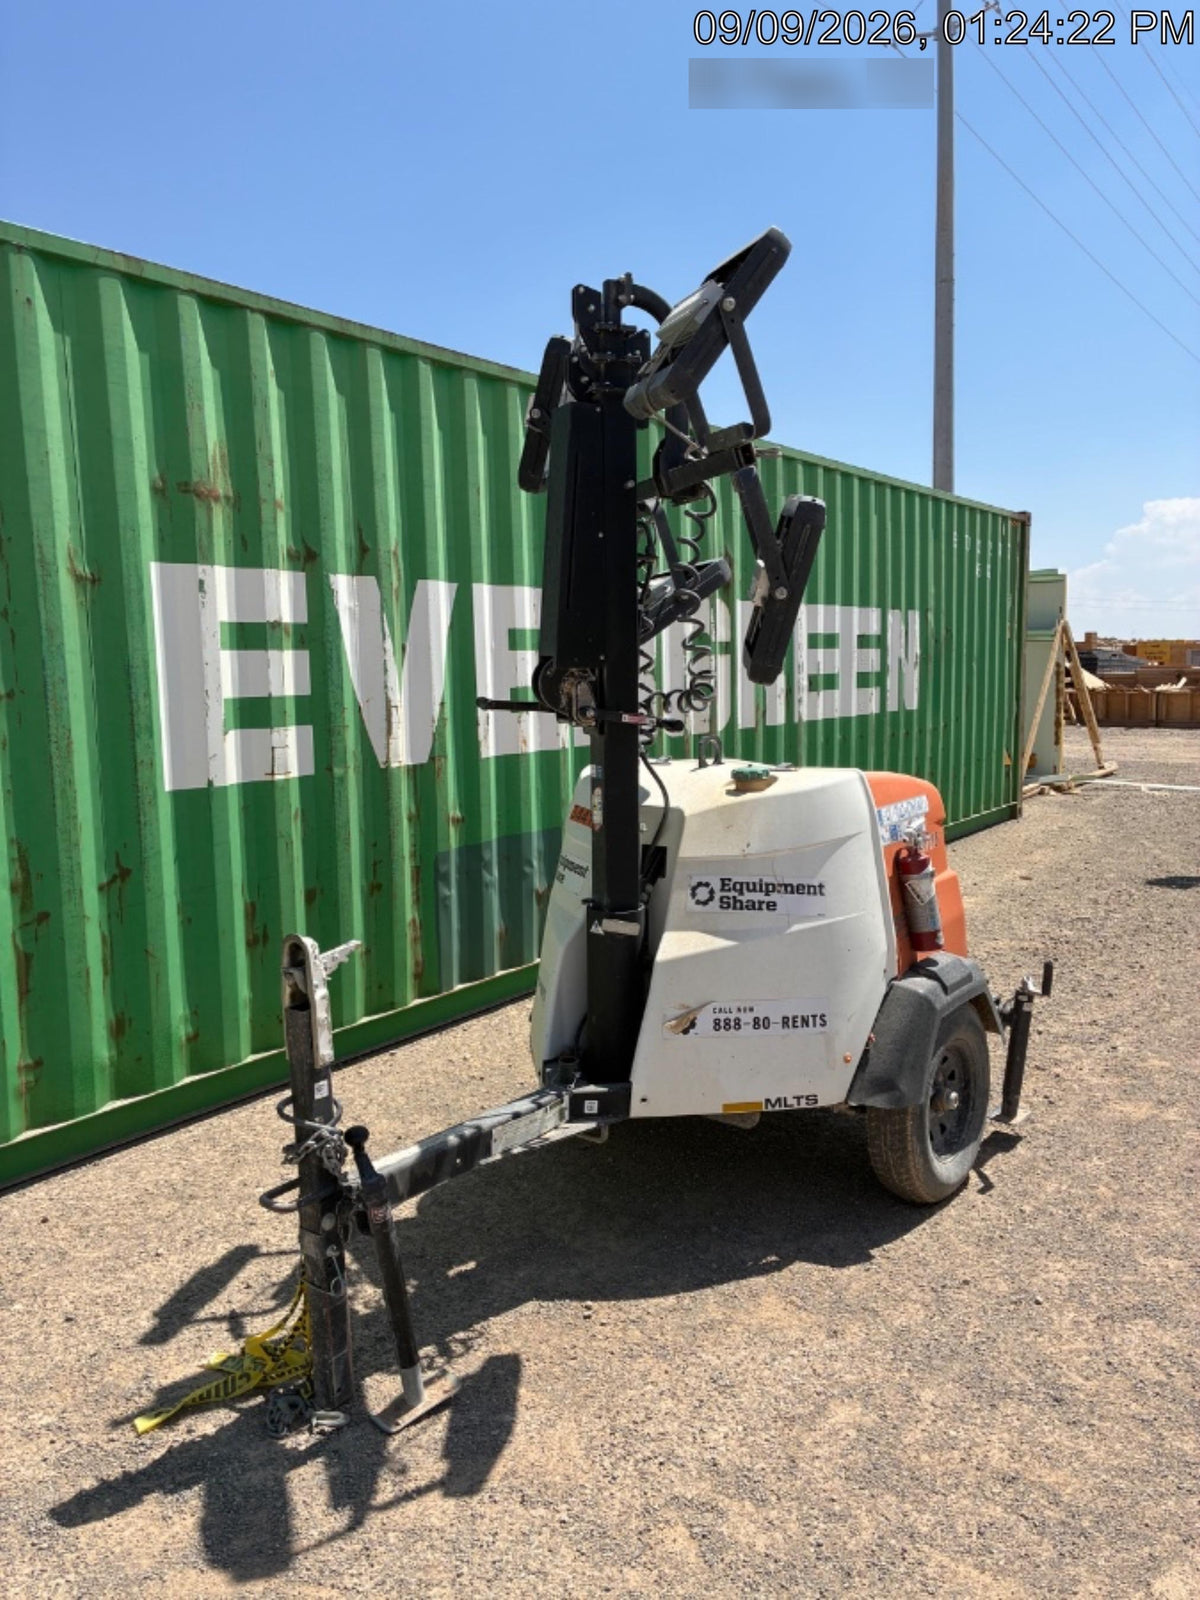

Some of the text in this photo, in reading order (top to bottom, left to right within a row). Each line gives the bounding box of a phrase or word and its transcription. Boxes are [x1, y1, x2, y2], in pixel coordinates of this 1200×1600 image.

[149, 561, 920, 791] EVEGREEN
[720, 878, 825, 896] Equipment
[719, 895, 777, 911] Share
[712, 1006, 733, 1014] CALL
[713, 1013, 827, 1031] 888-80-RENTS
[764, 1094, 819, 1110] MLTS
